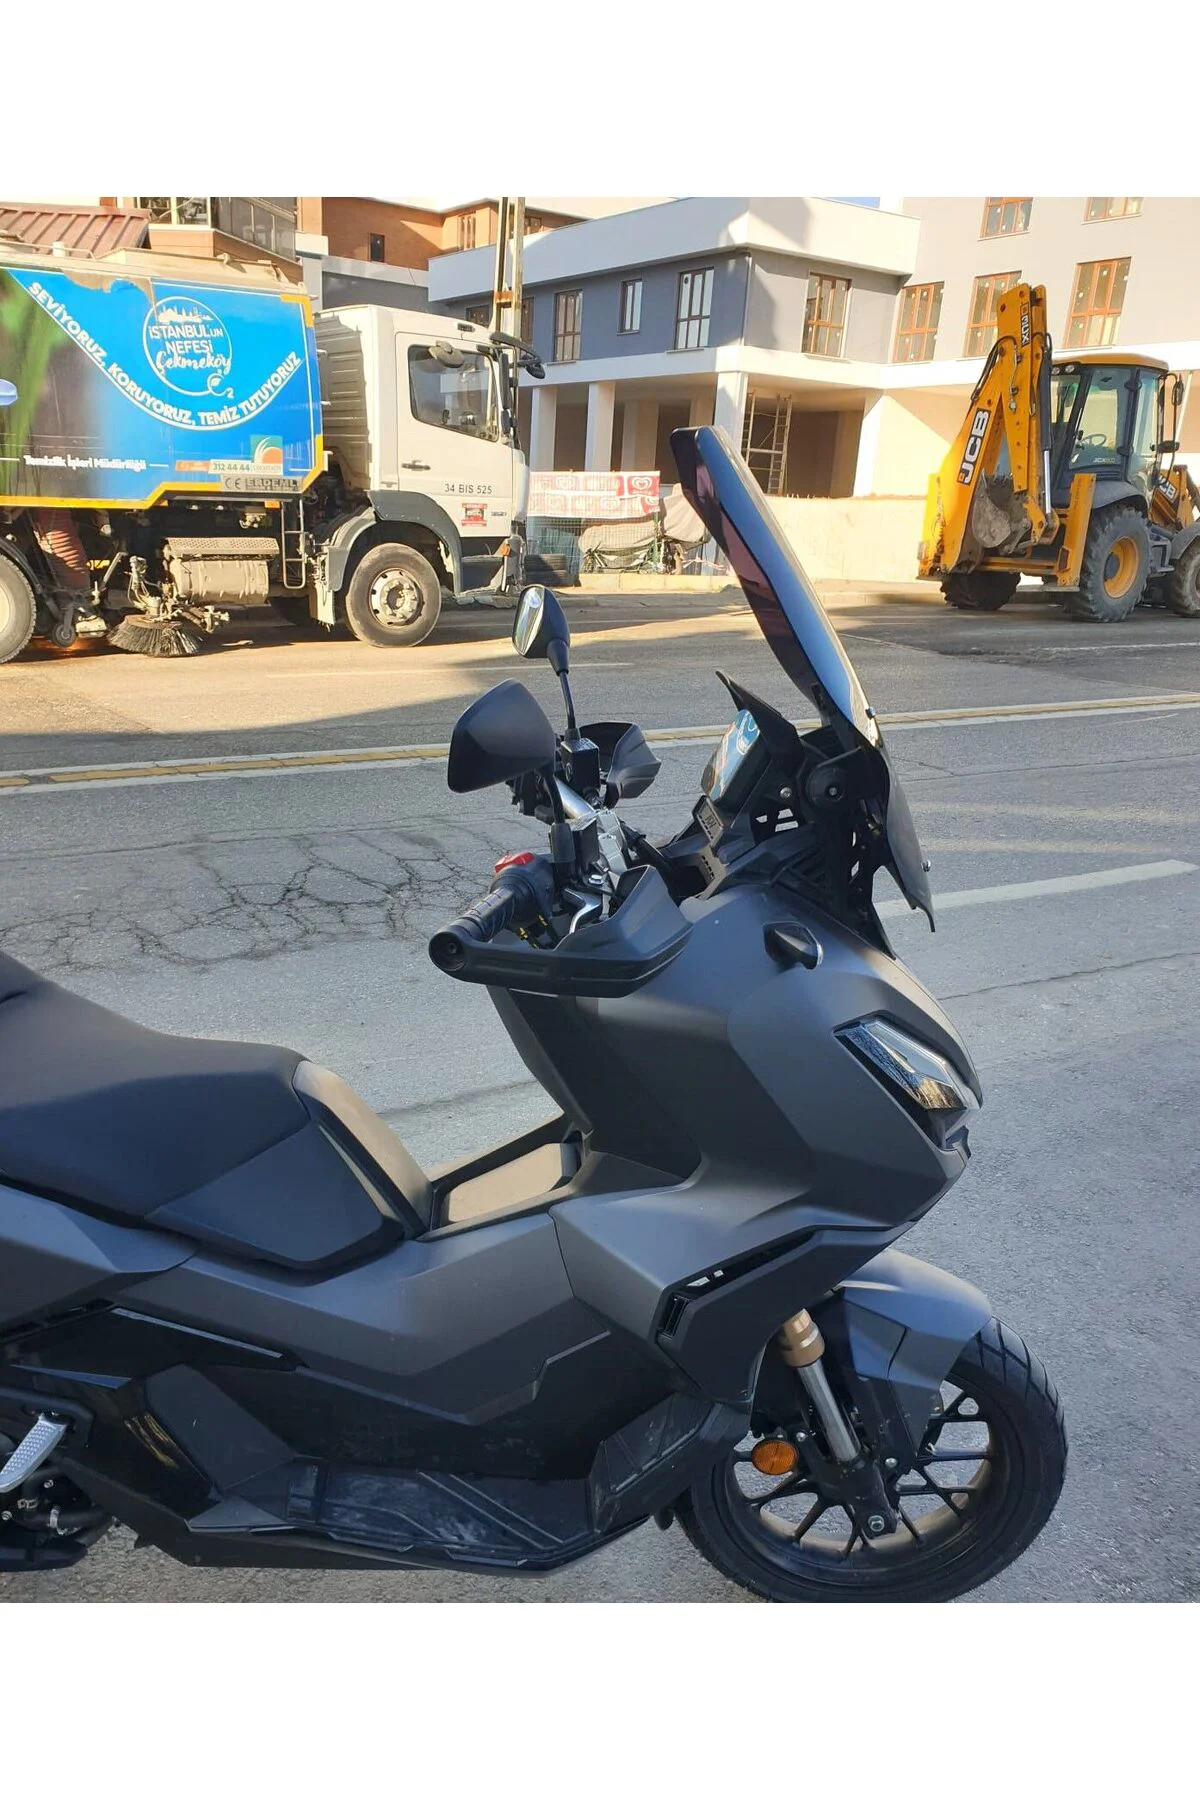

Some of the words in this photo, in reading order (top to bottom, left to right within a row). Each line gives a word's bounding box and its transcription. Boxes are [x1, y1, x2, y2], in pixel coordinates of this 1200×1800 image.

[107, 362, 196, 426] KORUYORUZ,
[197, 405, 241, 425] TEMİZ
[237, 351, 302, 416] TUTUYORUZ
[213, 463, 225, 471] 312
[227, 463, 238, 471] 44
[240, 463, 250, 471] 44
[958, 410, 989, 484] JCB
[444, 483, 455, 492] 34
[458, 484, 474, 494] BIS
[476, 485, 493, 494] 525
